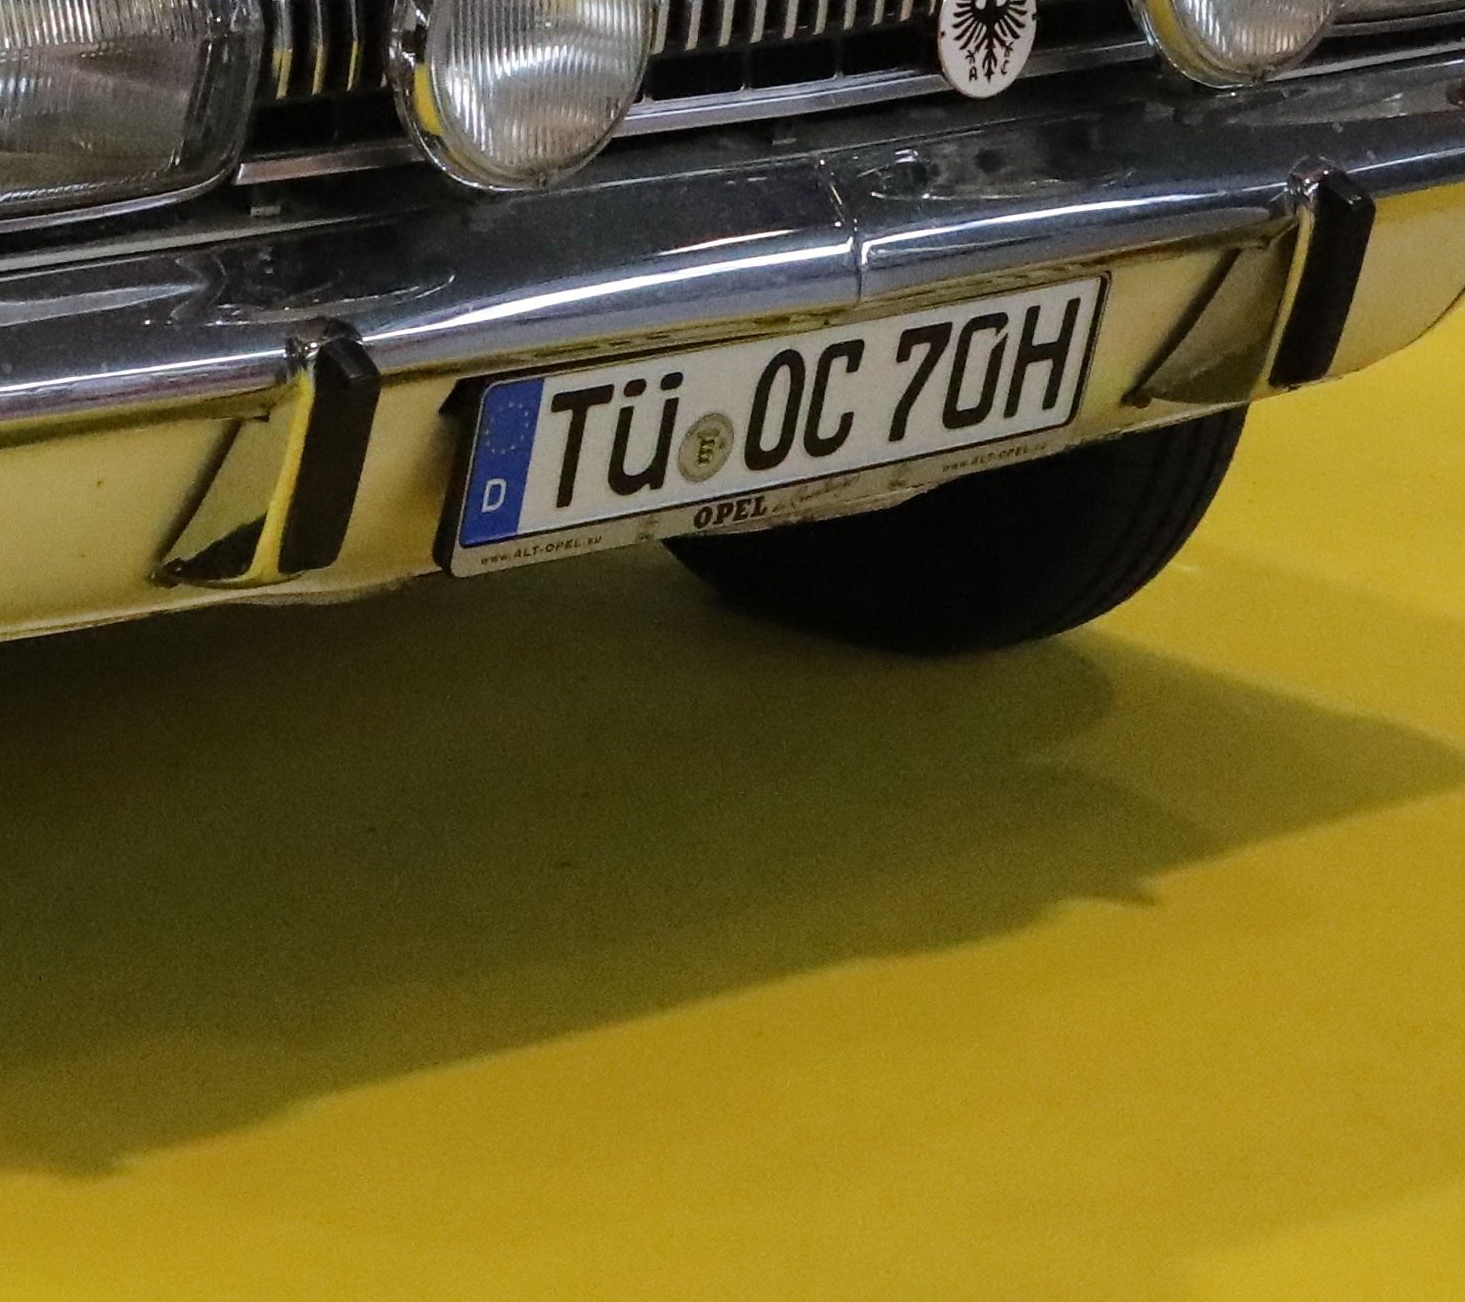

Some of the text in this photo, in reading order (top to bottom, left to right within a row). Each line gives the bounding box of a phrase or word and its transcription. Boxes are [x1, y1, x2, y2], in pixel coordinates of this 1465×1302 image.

[549, 296, 1083, 509] TÜ OC 70H
[481, 477, 507, 514] D
[692, 495, 770, 530] OPEL
